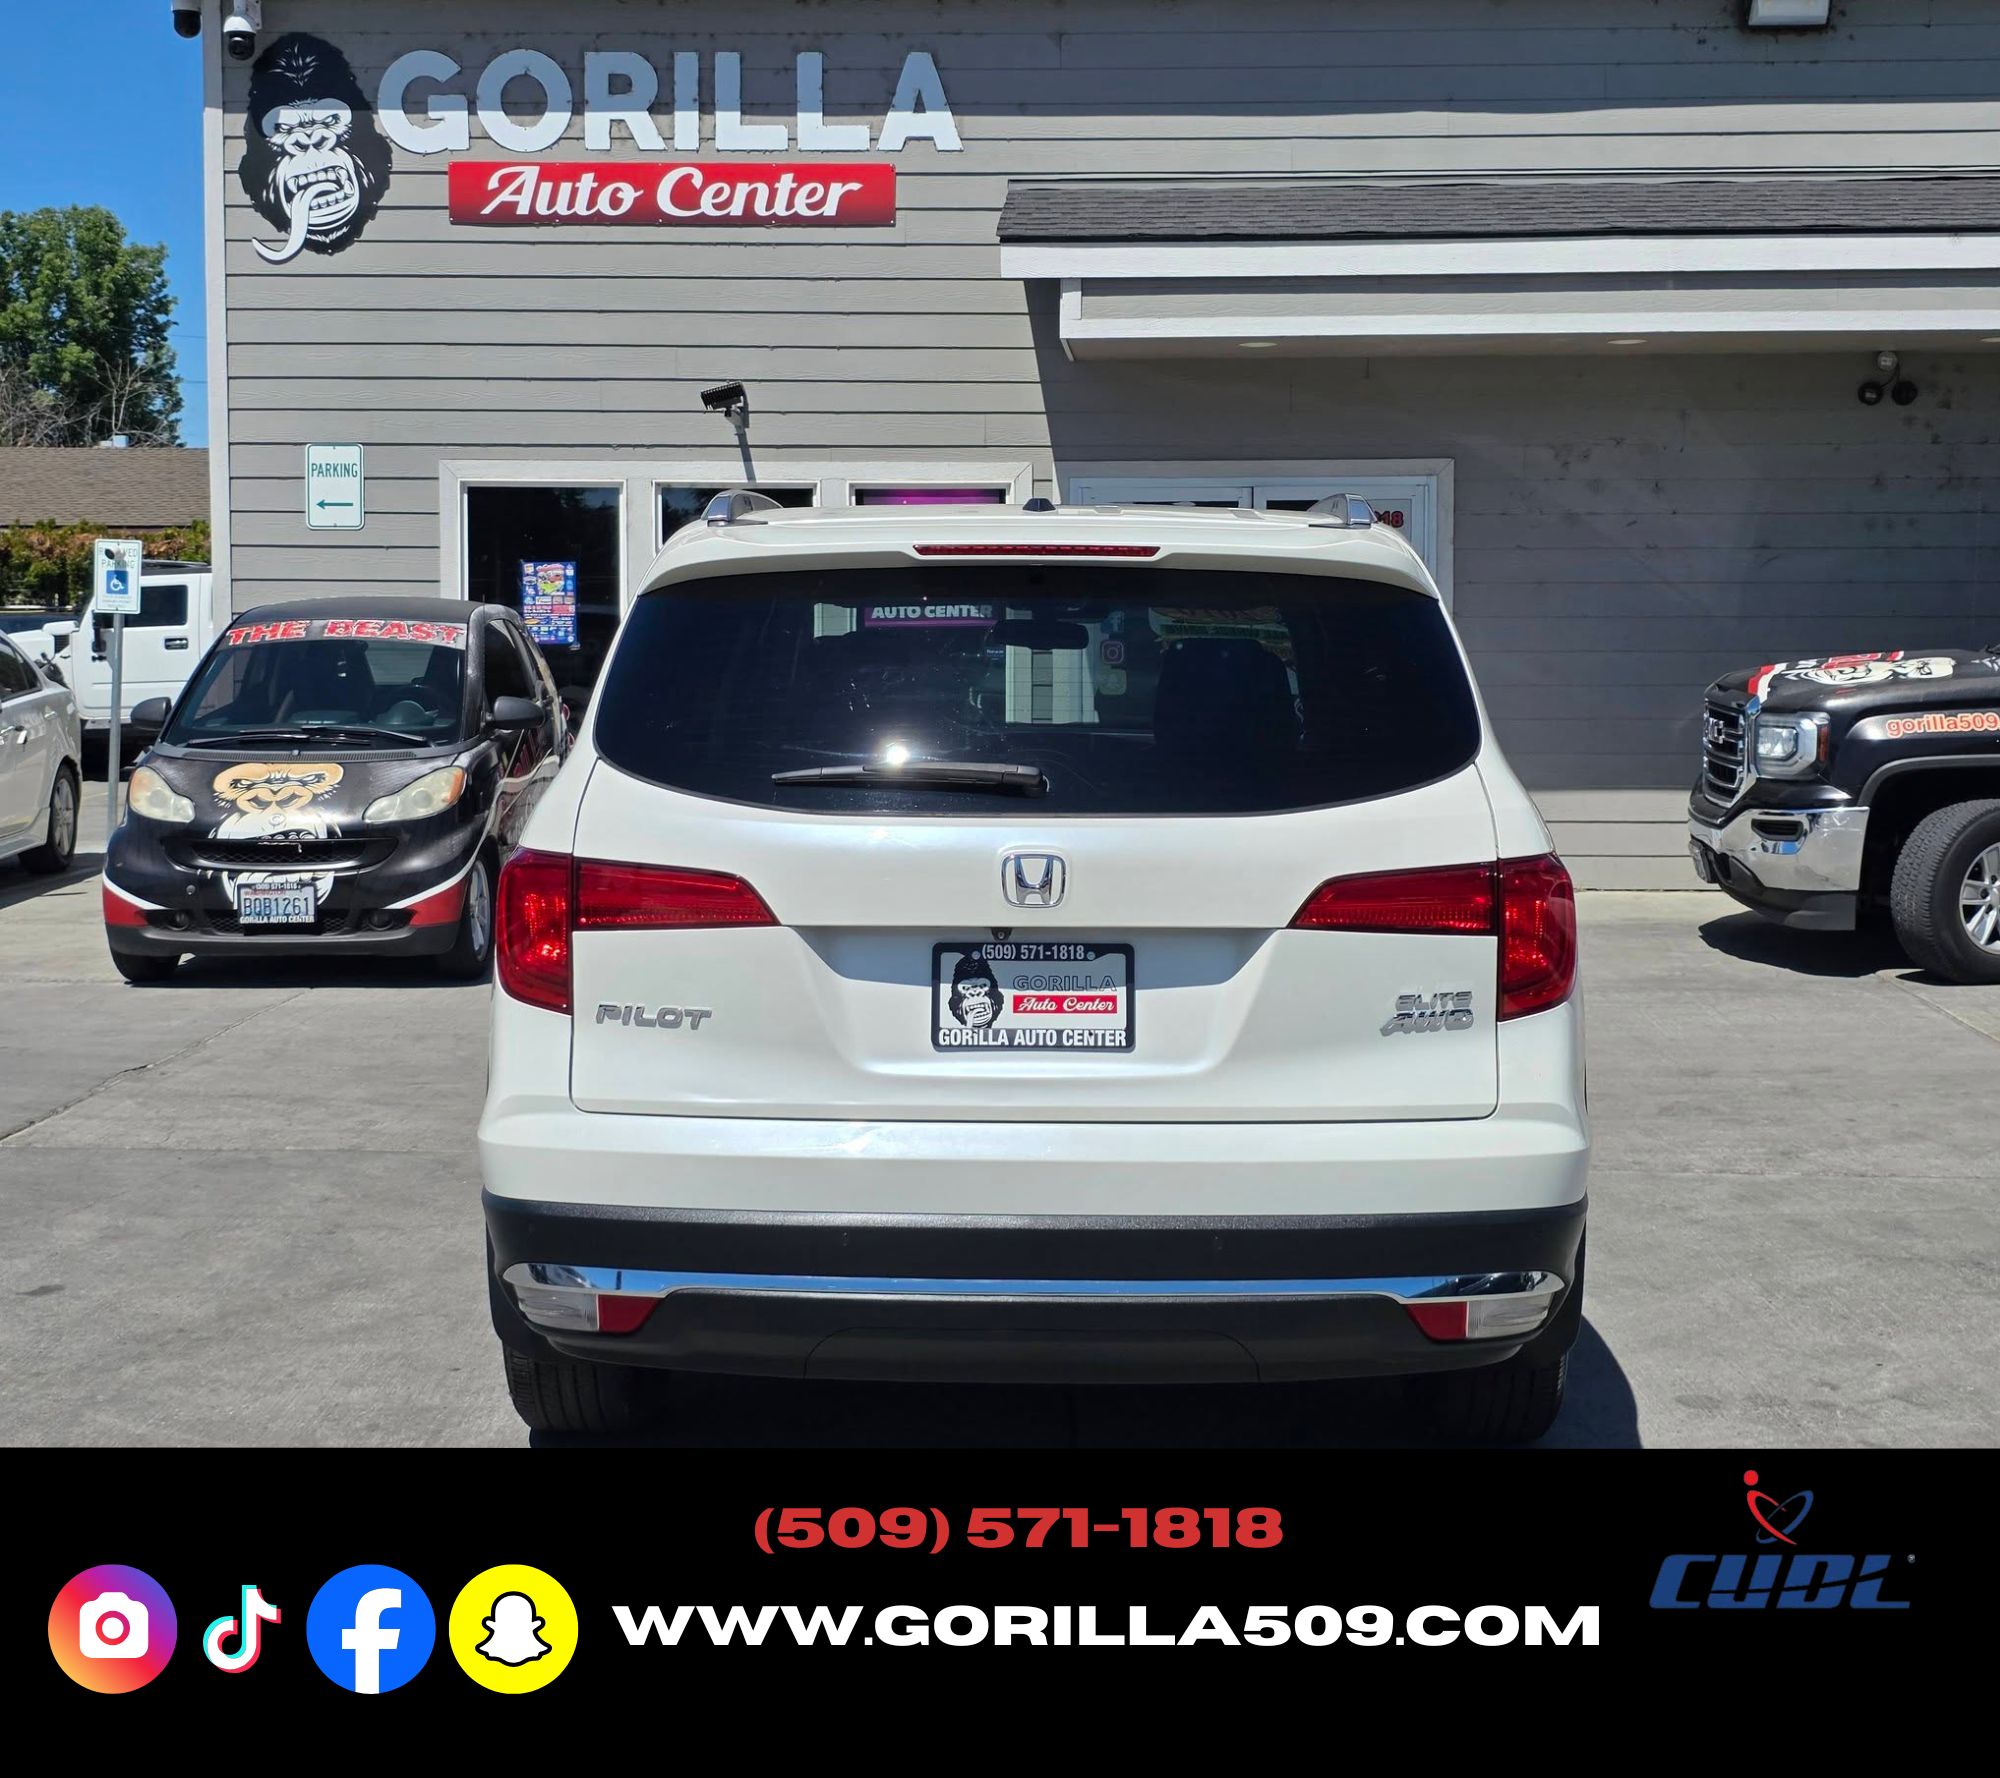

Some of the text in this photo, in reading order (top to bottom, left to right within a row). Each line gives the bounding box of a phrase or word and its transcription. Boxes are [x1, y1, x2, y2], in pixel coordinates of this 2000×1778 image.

[377, 49, 963, 154] GORILLA
[480, 165, 862, 217] Auto Center
[311, 462, 359, 478] PARKING
[871, 604, 993, 619] AUTO CENTER
[226, 619, 466, 646] THE BEAST
[243, 897, 309, 916] BQB1261
[270, 915, 288, 923] AUTO
[982, 944, 1085, 961] (509) 571-1818
[1012, 975, 1117, 992] GORILLA
[1018, 997, 1115, 1012] Auto Center
[1395, 991, 1472, 1011] ELITE
[596, 1004, 712, 1030] PILOT
[1380, 1009, 1474, 1037] AWD
[1013, 1029, 1058, 1046] AUTO
[1062, 1029, 1127, 1047] CENTER
